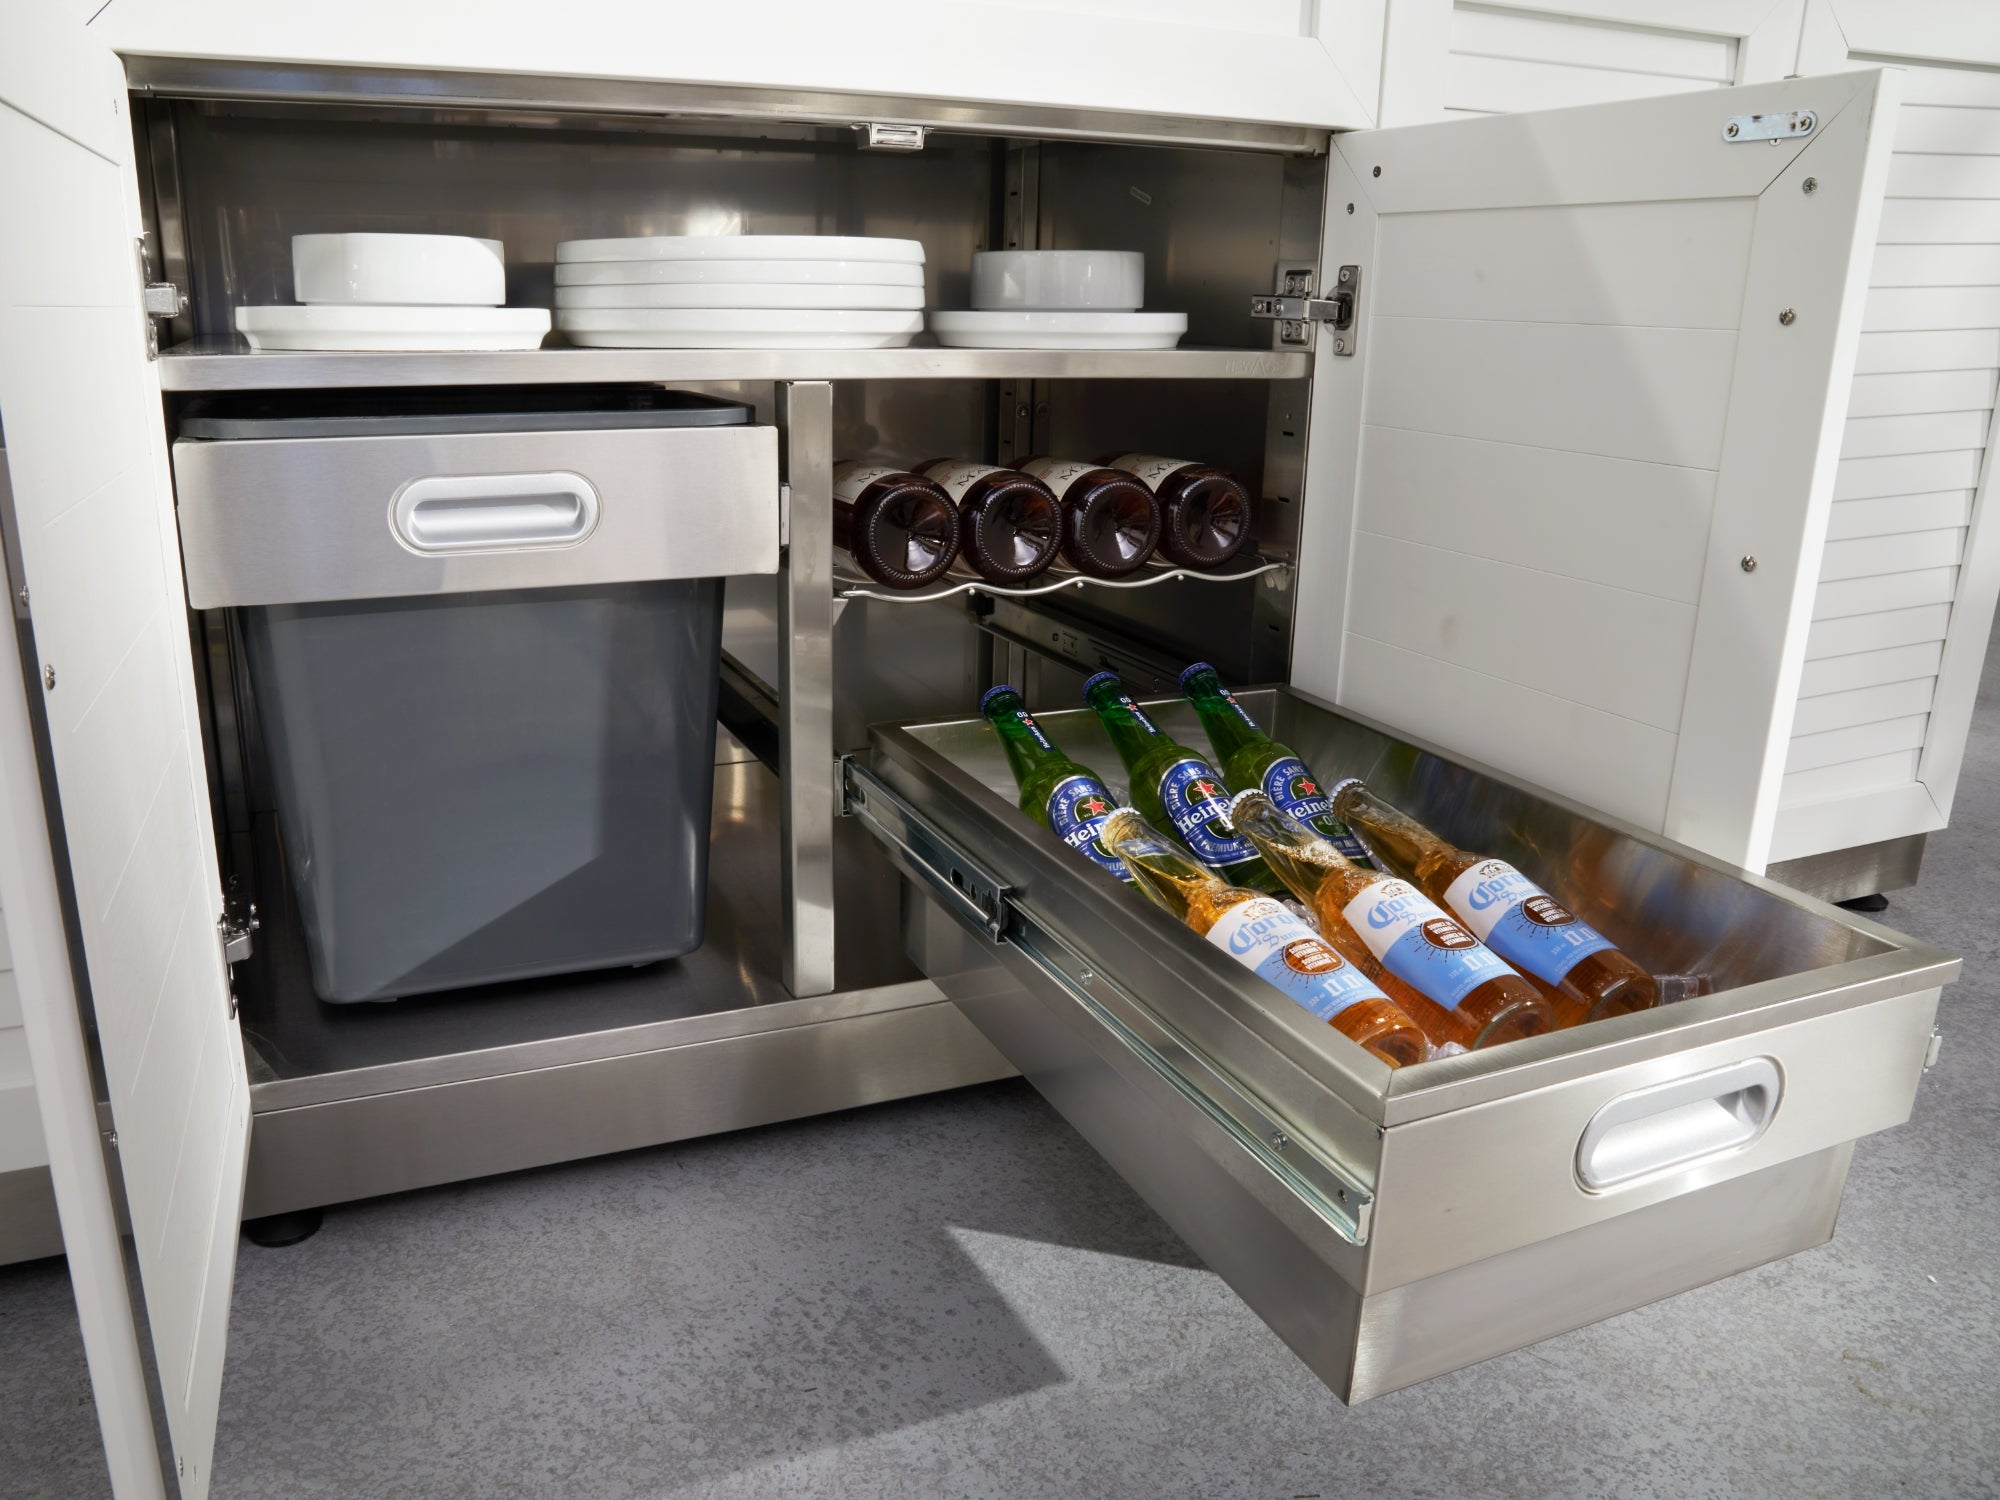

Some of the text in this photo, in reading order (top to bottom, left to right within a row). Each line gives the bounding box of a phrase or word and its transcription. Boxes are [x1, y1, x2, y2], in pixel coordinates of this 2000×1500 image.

[1177, 767, 1202, 781] SANS
[1282, 765, 1305, 776] SANS
[1068, 784, 1093, 797] SANS
